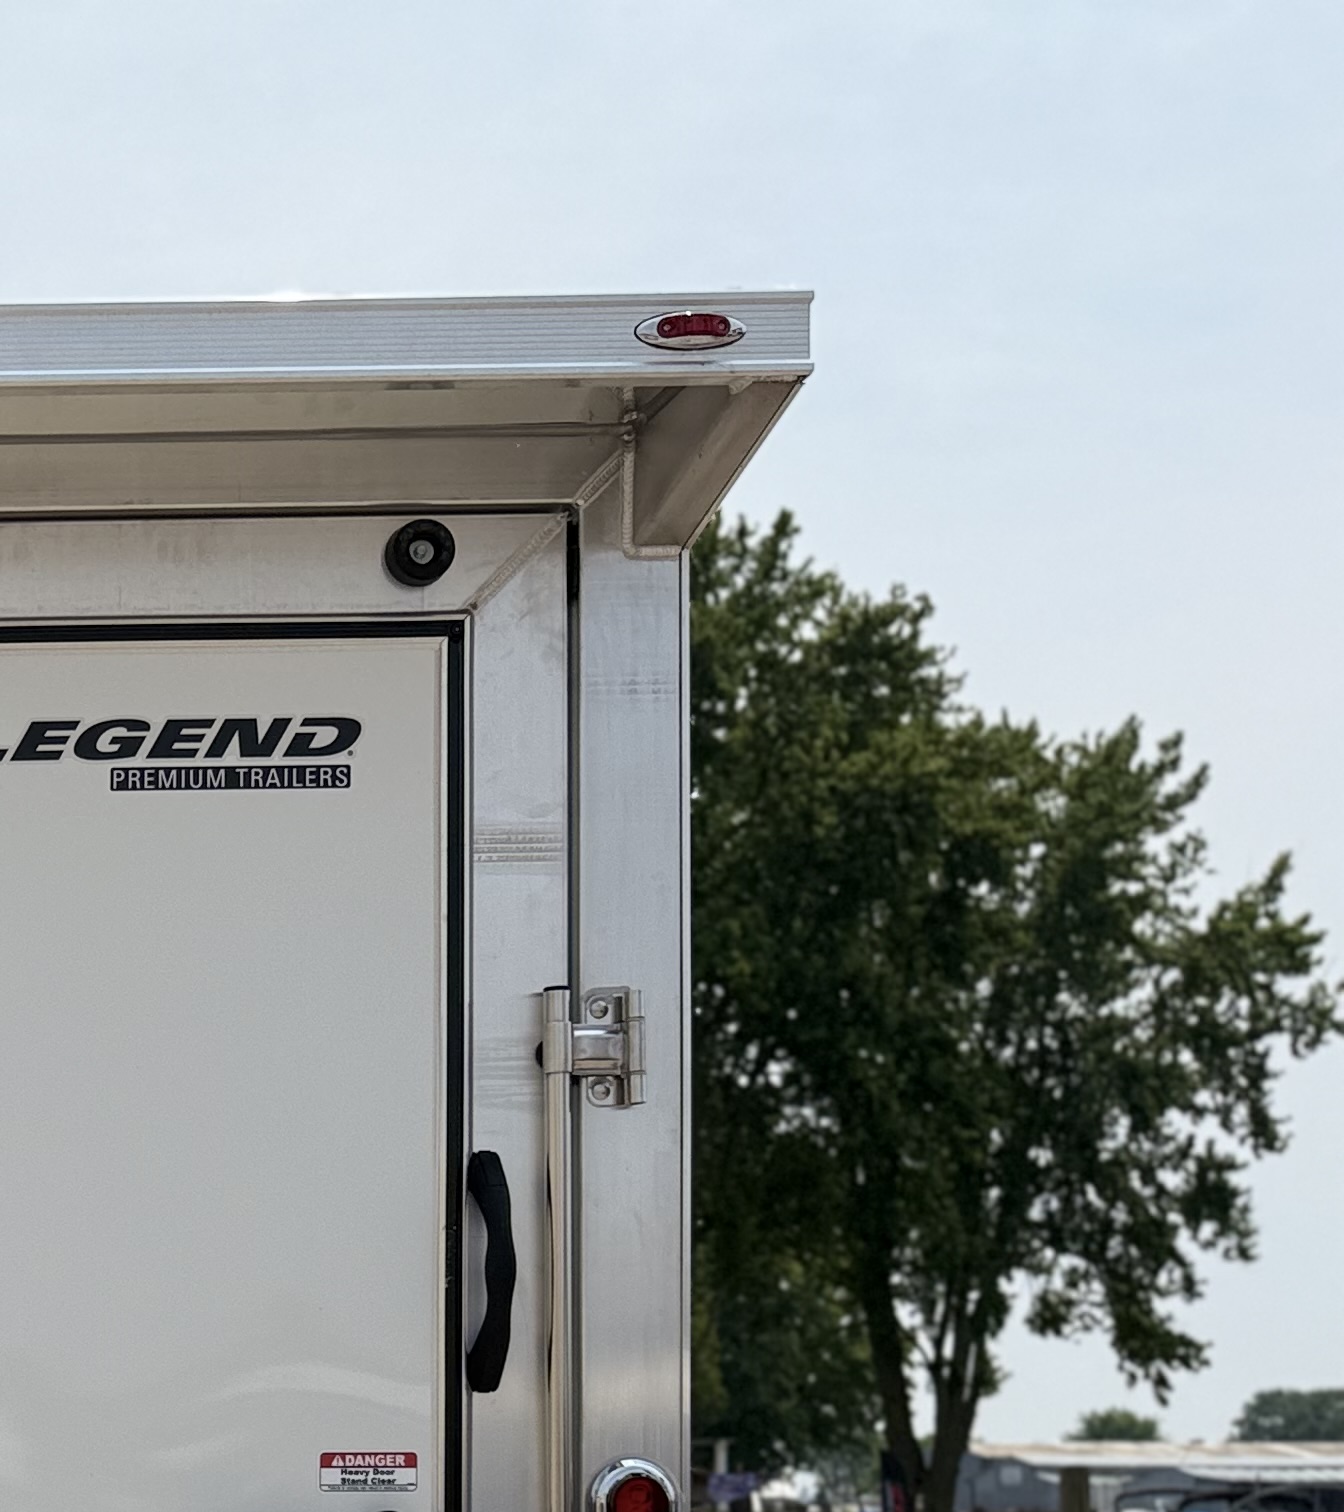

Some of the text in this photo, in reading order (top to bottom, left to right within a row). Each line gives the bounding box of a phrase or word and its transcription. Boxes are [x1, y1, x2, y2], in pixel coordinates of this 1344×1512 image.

[113, 766, 349, 790] PREMIUM TRAILERS
[345, 1454, 405, 1467] DANGER
[340, 1469, 370, 1477] Heavy
[340, 1477, 397, 1485] Stand Clear
